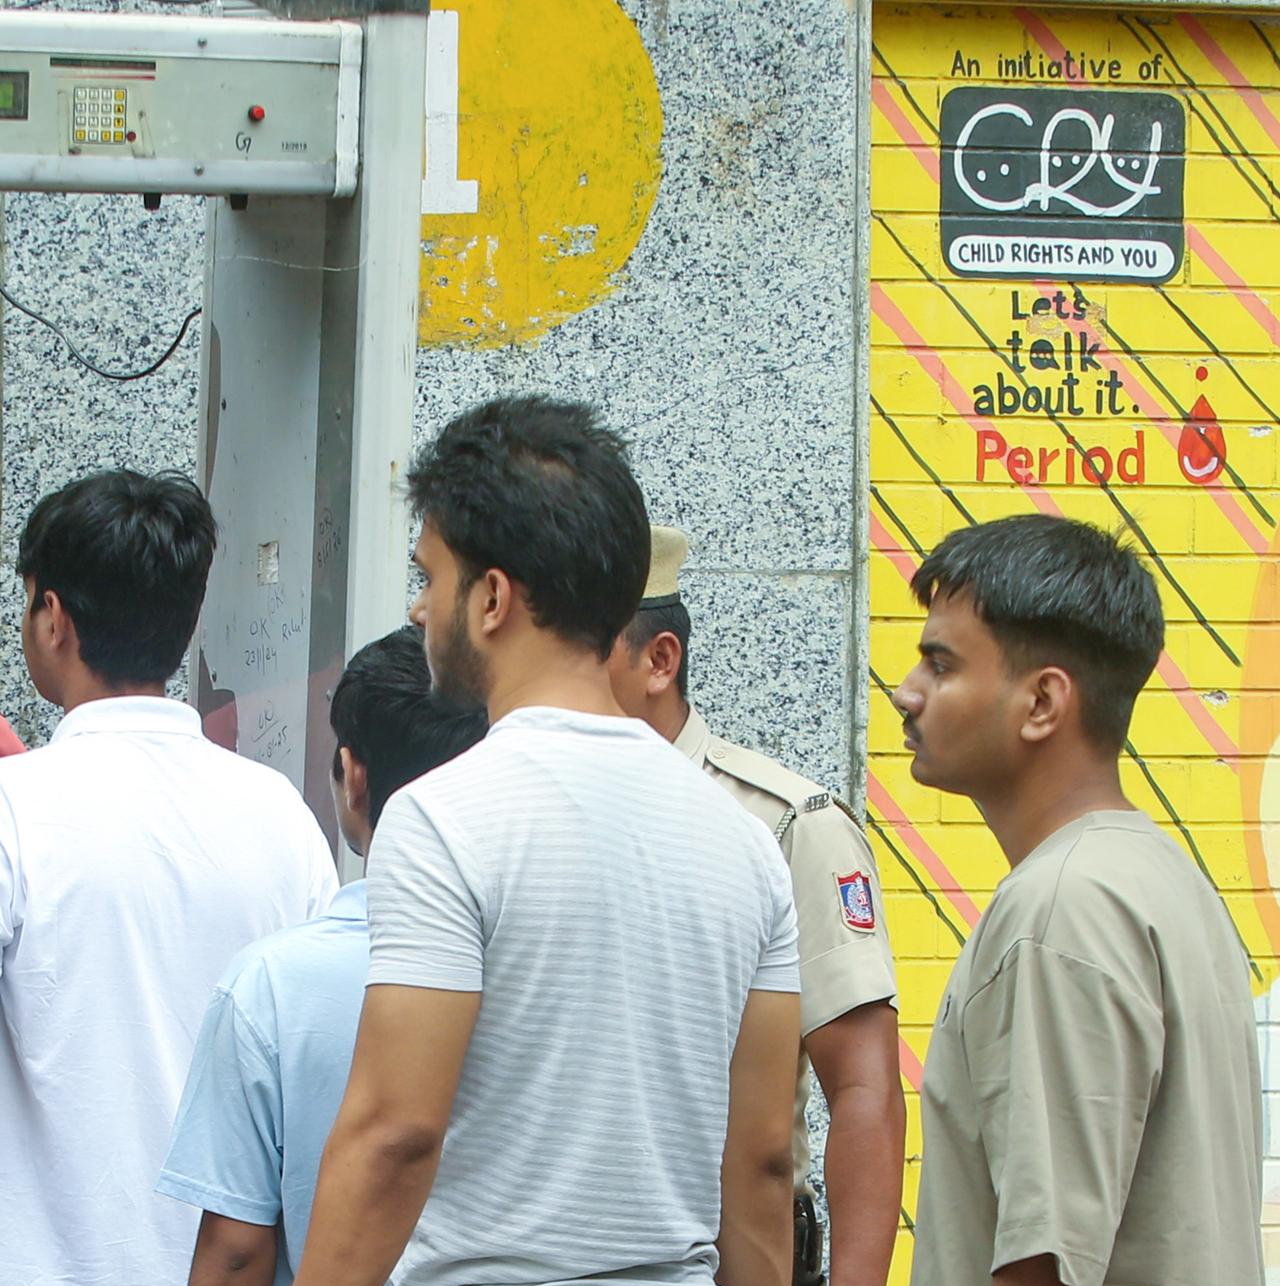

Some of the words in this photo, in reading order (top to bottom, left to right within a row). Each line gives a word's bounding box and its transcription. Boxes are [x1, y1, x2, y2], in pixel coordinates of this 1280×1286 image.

[950, 50, 981, 78] An
[997, 50, 1122, 80] initiative
[1138, 52, 1166, 80] of
[957, 243, 1005, 265] CHILD
[1011, 242, 1074, 265] RIGHTS
[1077, 245, 1115, 266] AND
[1120, 246, 1158, 269] YOU
[1006, 330, 1103, 374] talk
[972, 372, 1083, 416] about
[975, 429, 1145, 485] Period
[249, 618, 272, 641] OK
